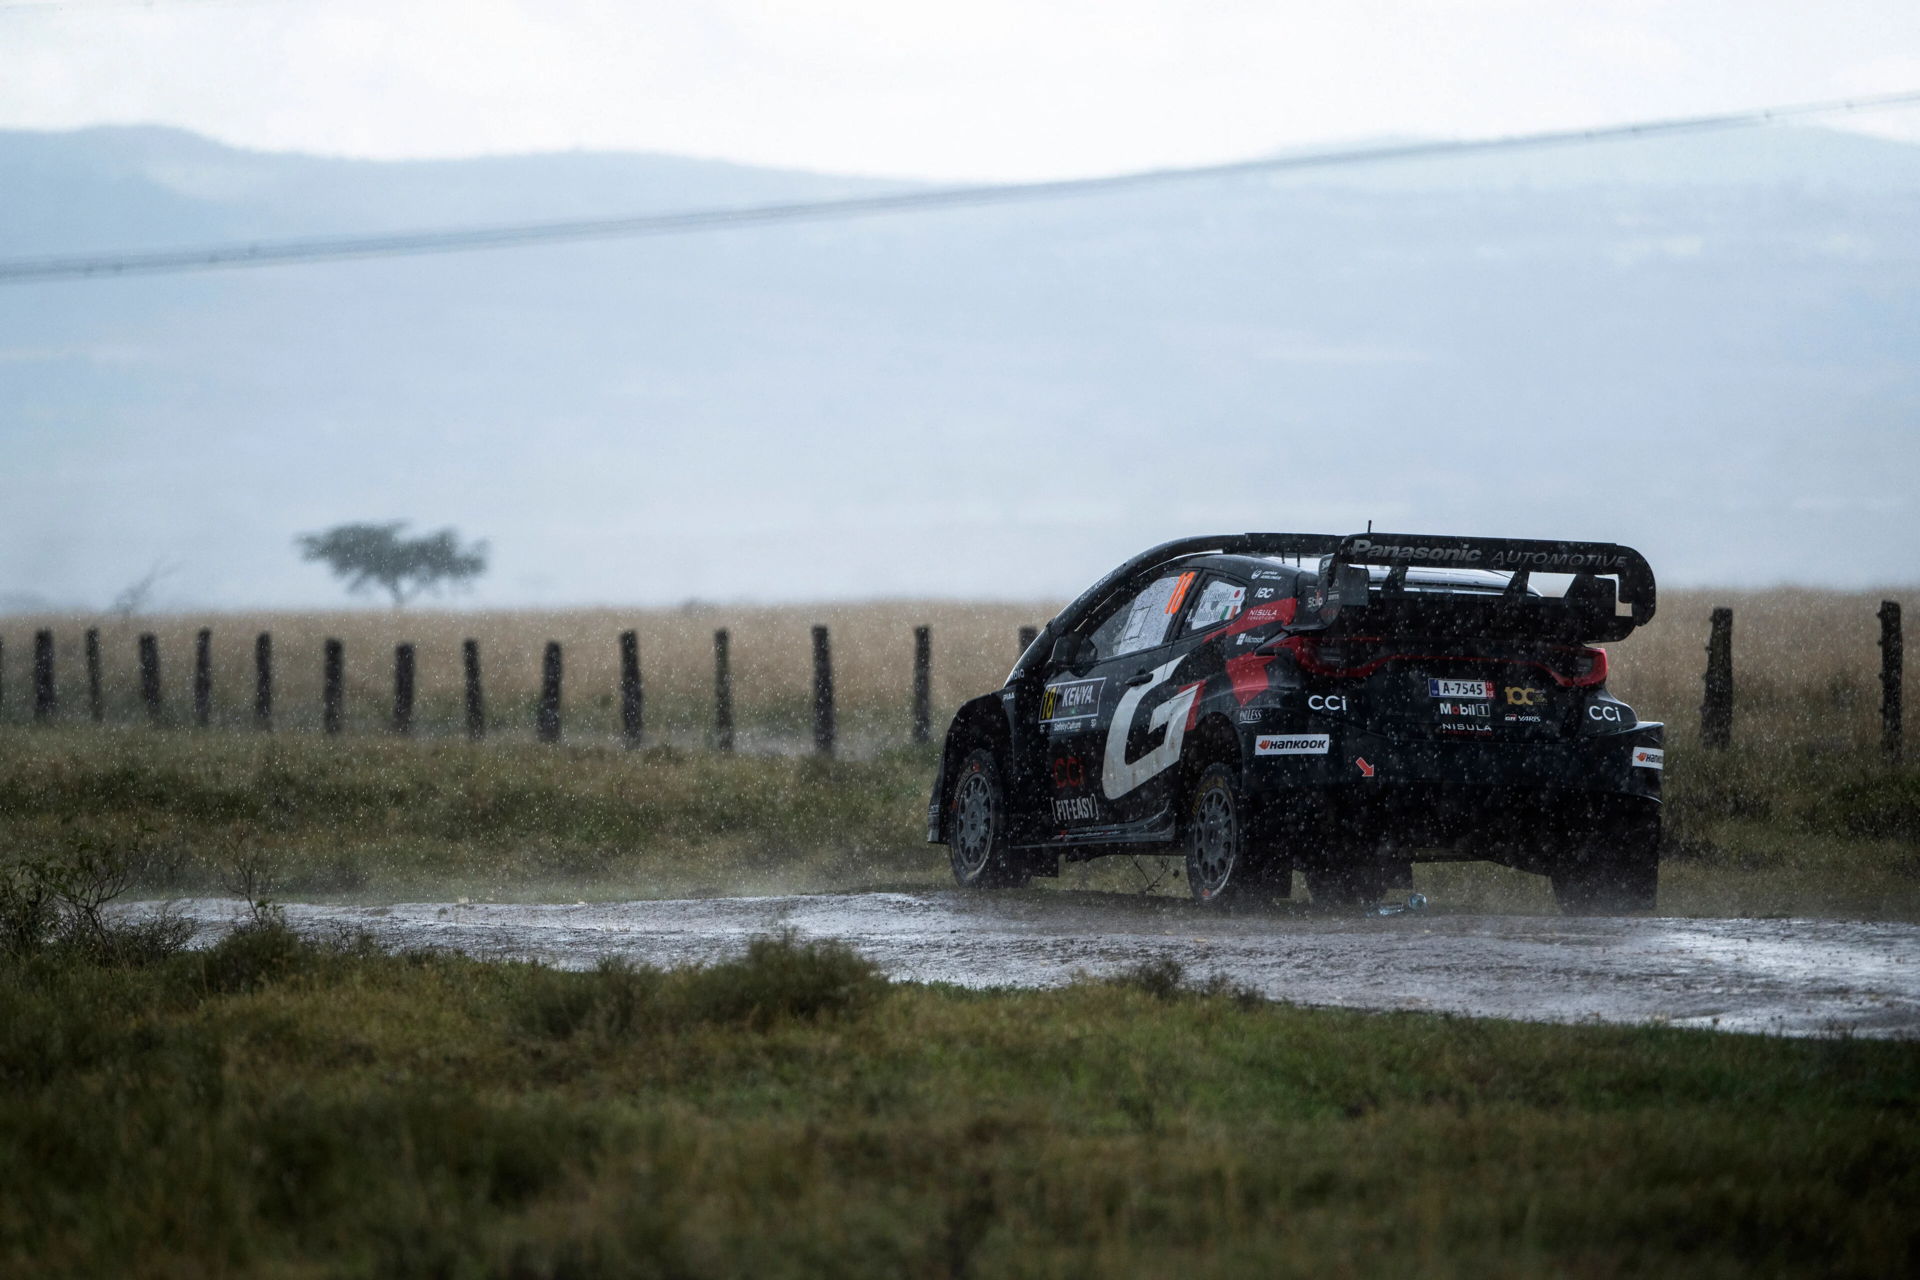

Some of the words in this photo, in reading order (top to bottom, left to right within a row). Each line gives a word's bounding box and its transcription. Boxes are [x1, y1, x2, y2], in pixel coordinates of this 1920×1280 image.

[1350, 539, 1483, 562] Panasonic
[1490, 549, 1628, 568] AUTOMOTIVE
[1164, 571, 1196, 615] 18
[1442, 682, 1483, 695] A-7545
[1040, 686, 1057, 720] 18
[1061, 684, 1094, 707] KENYA
[1439, 702, 1476, 716] Mobil
[1518, 714, 1541, 723] YARIS
[1441, 723, 1493, 732] NISULA
